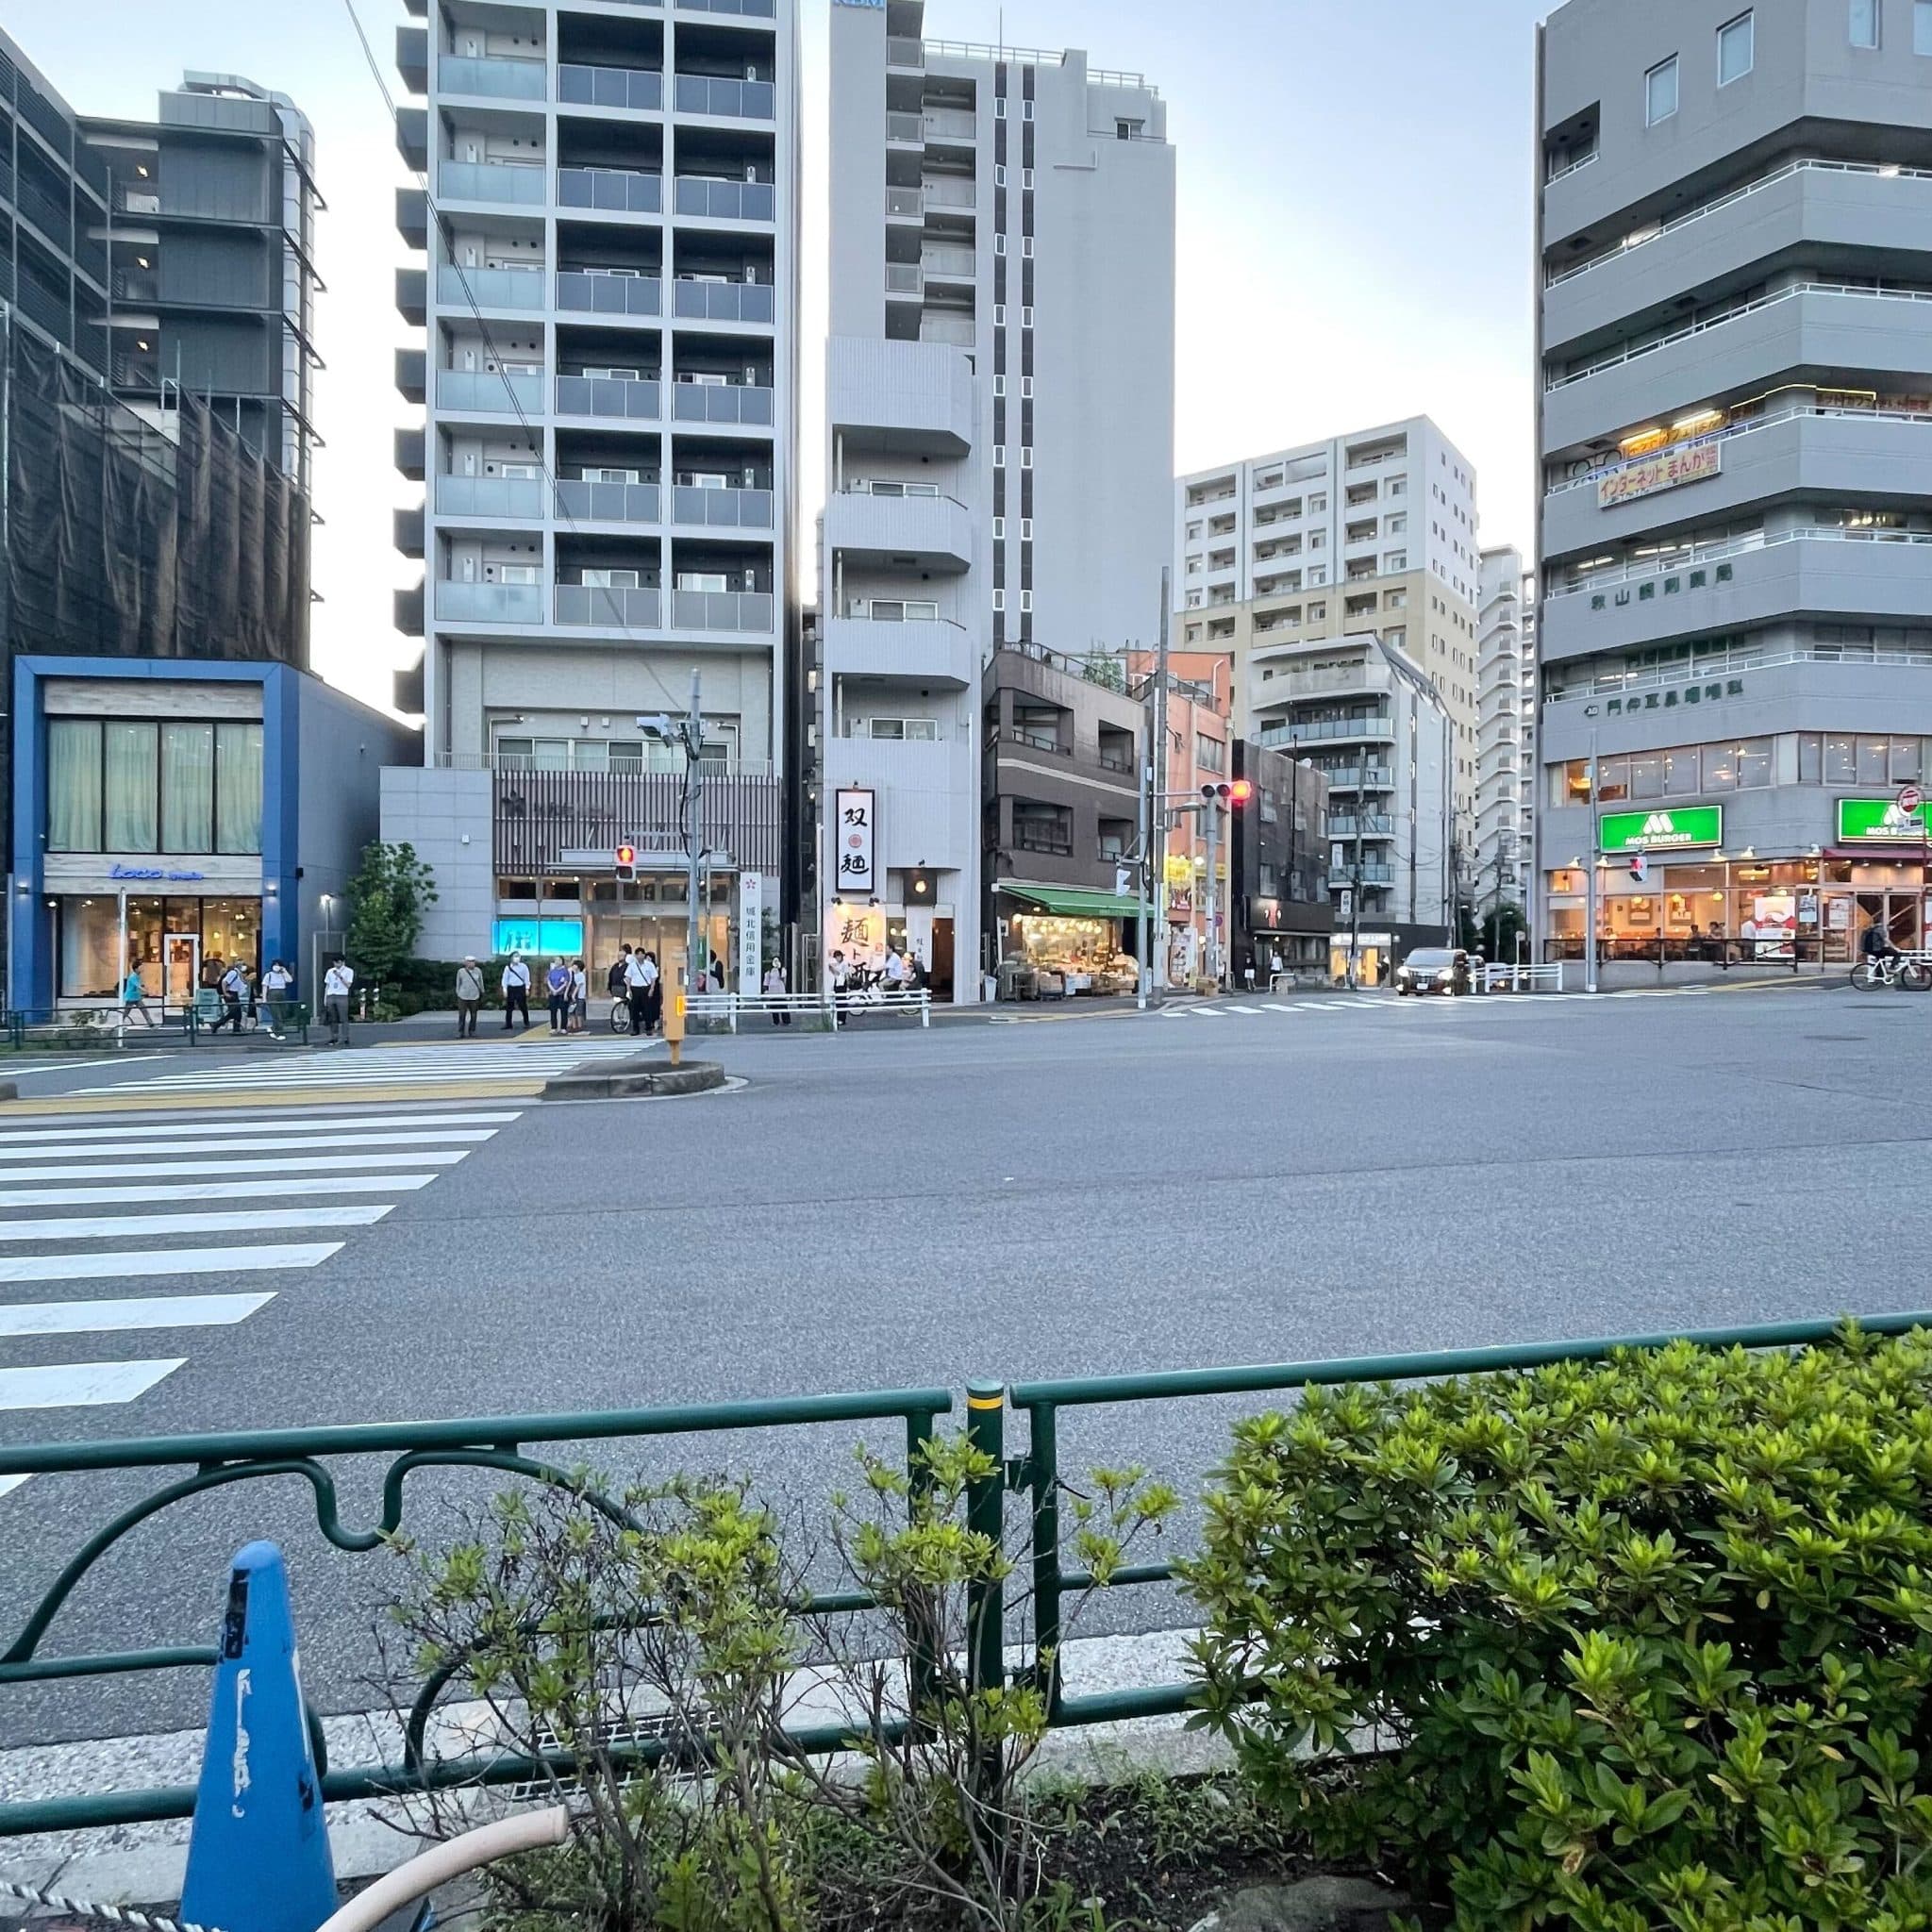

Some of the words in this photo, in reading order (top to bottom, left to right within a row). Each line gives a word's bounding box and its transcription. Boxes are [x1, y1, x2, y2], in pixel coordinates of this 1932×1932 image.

[1601, 465, 1663, 498] インターネット
[1625, 836, 1649, 846] MOS
[1650, 833, 1692, 843] BURGER
[1866, 826, 1890, 836] MOS
[745, 906, 756, 977] 城北信用金庫
